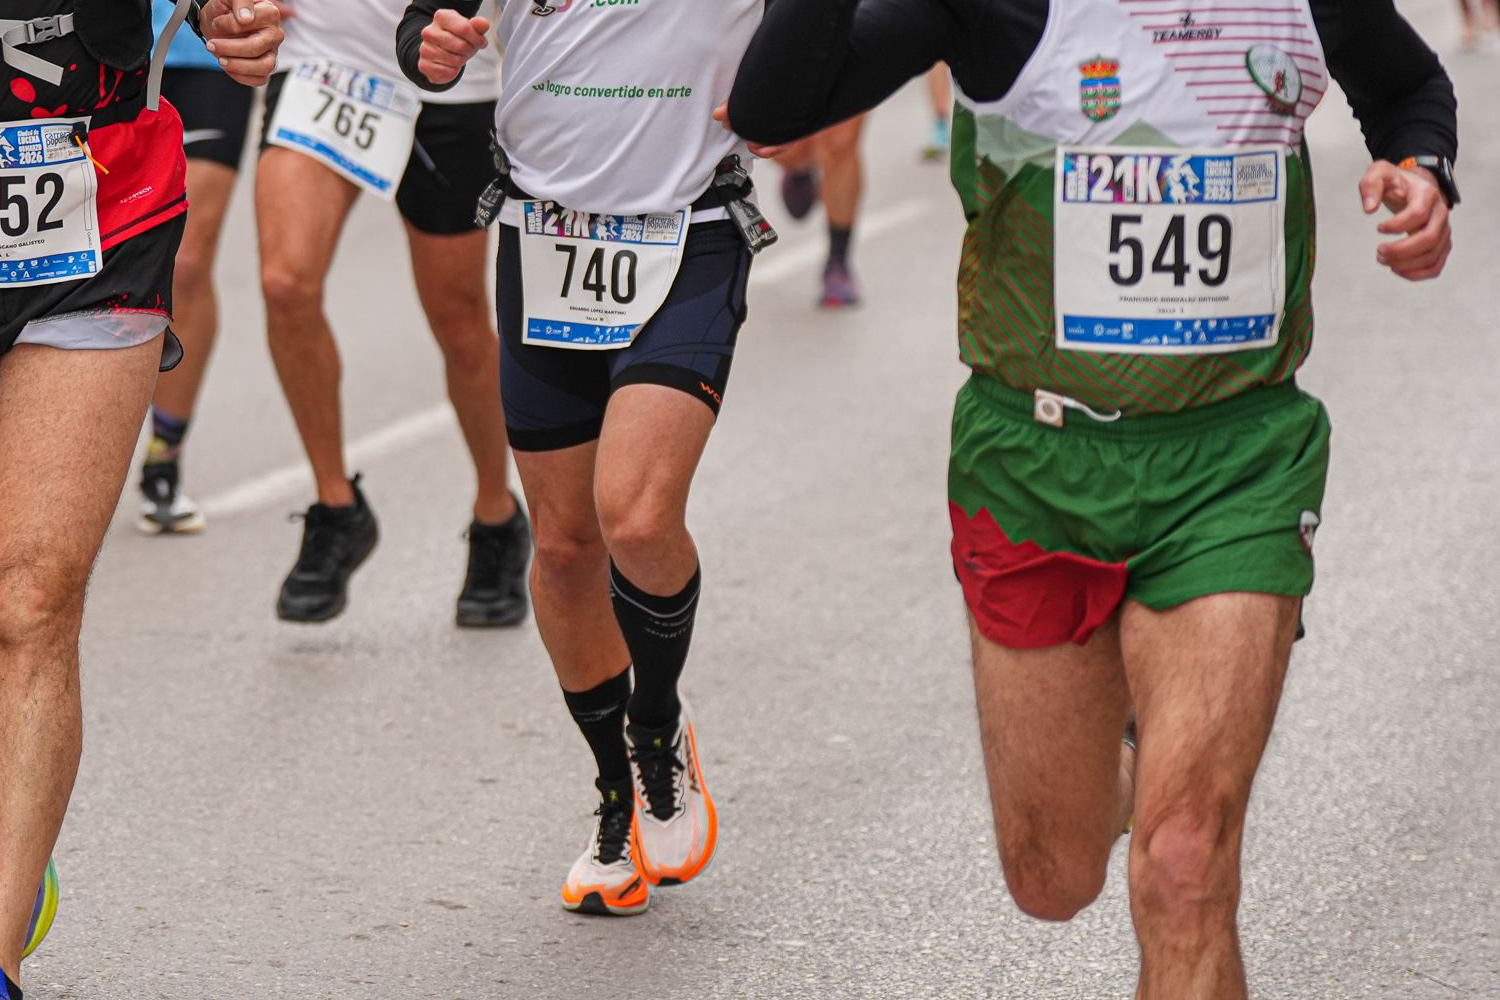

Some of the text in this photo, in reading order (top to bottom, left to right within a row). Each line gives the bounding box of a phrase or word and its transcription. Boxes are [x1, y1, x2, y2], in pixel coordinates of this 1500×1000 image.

[546, 79, 572, 96] logro
[573, 82, 644, 98] convertido
[647, 85, 664, 98] en
[666, 85, 692, 98] arte
[313, 88, 381, 149] 765
[19, 151, 43, 164] 2026
[1090, 155, 1163, 203] 21K
[18, 239, 45, 248] GALISTEO
[620, 229, 642, 242] 2026
[1108, 213, 1233, 287] 549
[555, 243, 638, 304] 740
